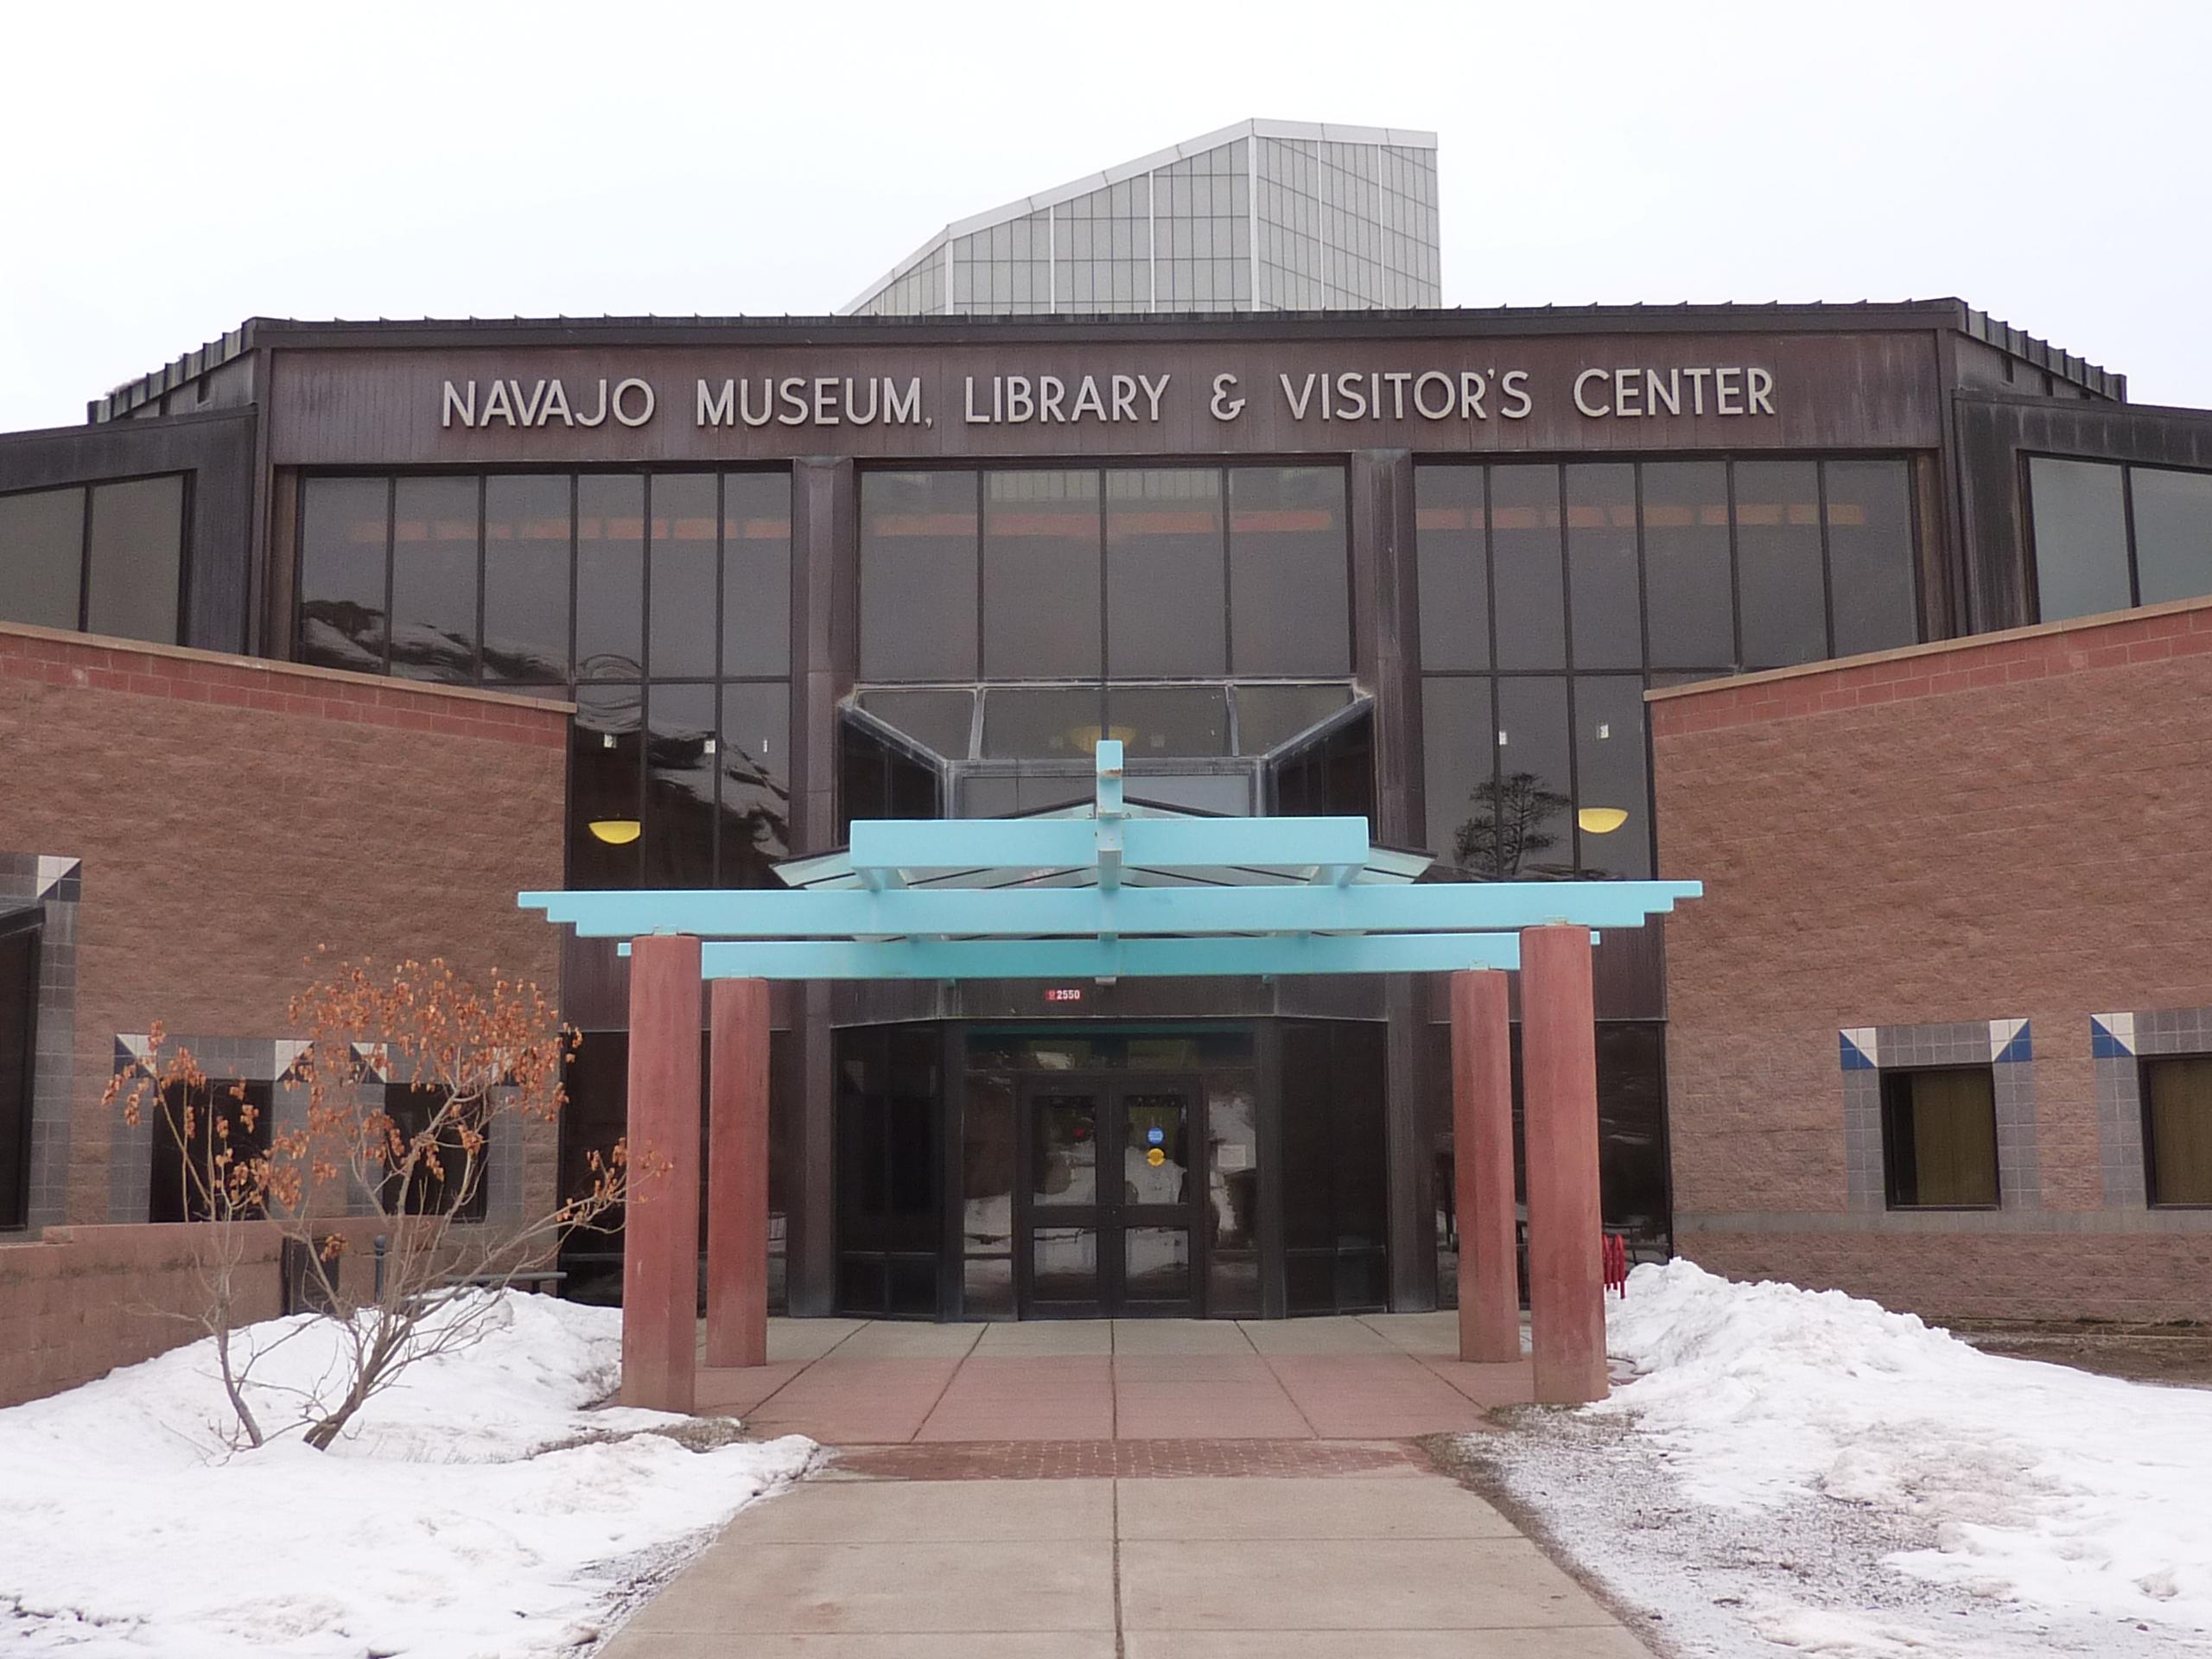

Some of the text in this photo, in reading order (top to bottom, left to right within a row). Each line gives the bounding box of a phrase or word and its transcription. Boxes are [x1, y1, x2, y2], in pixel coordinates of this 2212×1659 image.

[442, 367, 1776, 429] NAVAJO MUSEUM, LIBRARY & VISITOR'S CENTER
[1056, 989, 1081, 1000] 2550
